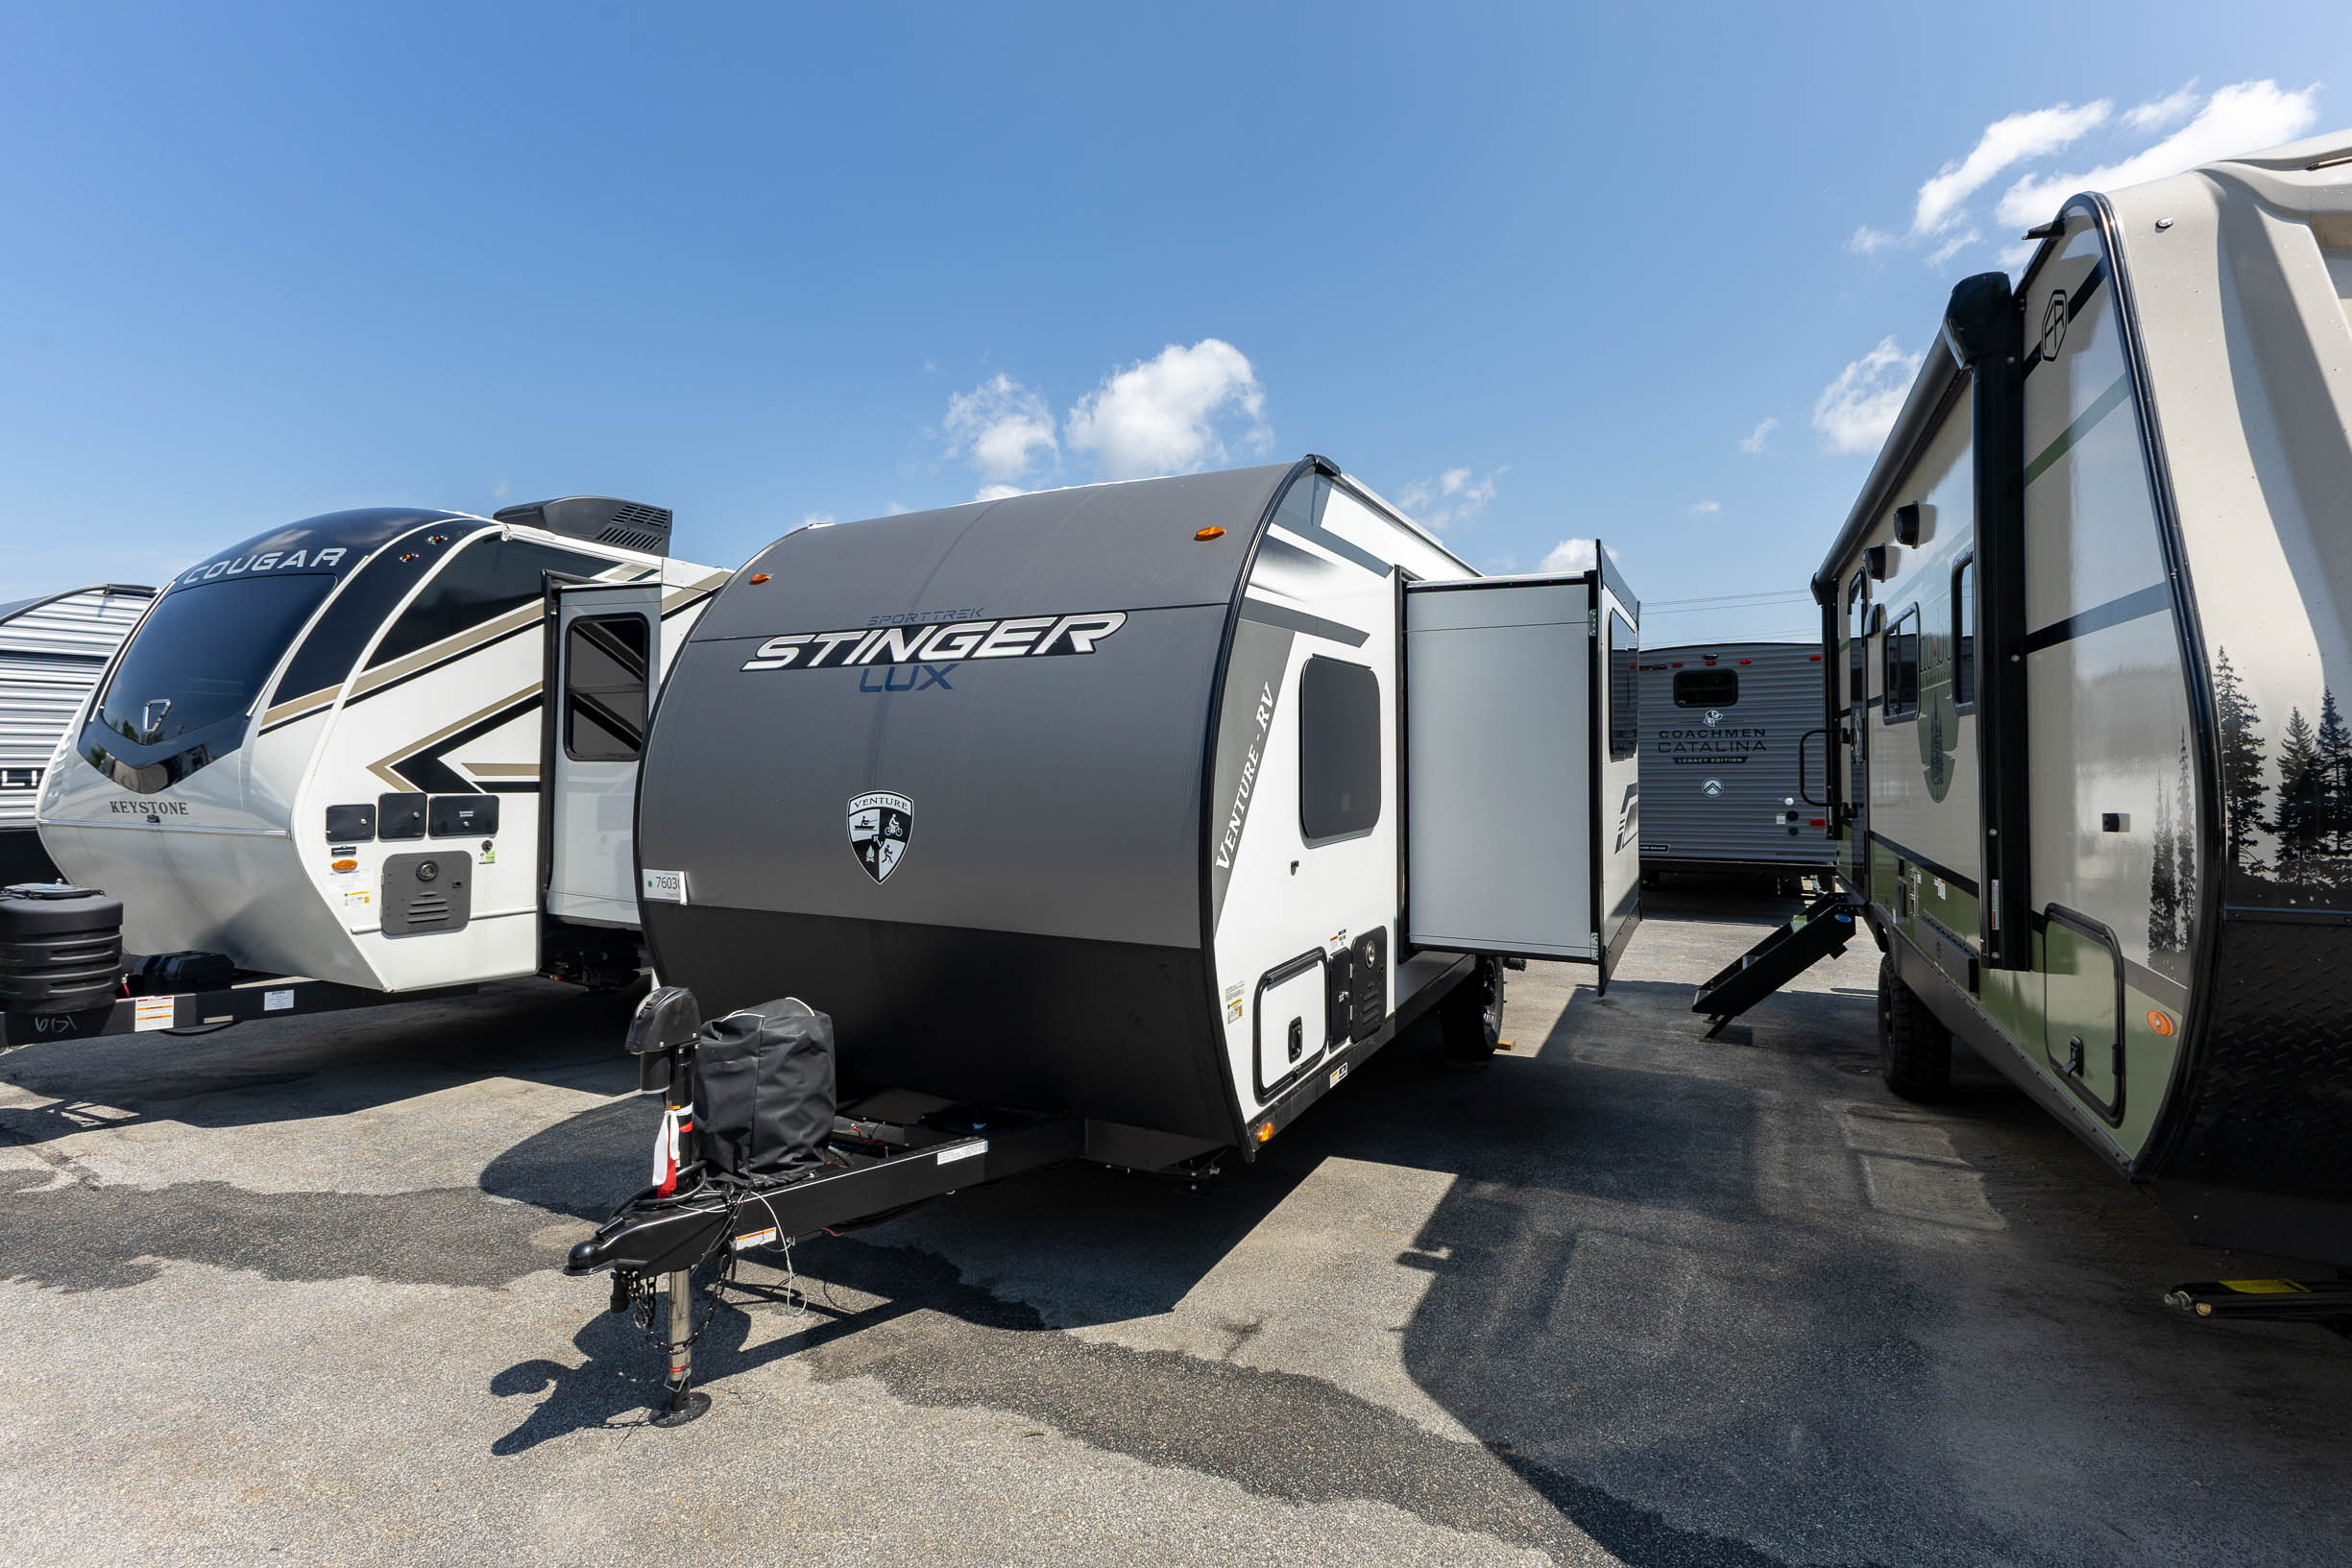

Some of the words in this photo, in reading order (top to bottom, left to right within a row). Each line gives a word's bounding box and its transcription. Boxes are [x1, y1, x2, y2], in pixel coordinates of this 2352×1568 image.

[182, 547, 348, 585] COUGAR
[867, 608, 984, 627] SPORTTREK
[740, 612, 1128, 671] STINGER
[859, 663, 960, 692] LUX
[1659, 728, 1766, 739] COACHMEN
[1658, 739, 1767, 754] CATALINA
[1215, 744, 1260, 870] VENTURE
[1255, 681, 1274, 733] RV
[109, 800, 189, 815] KEYSTONE
[854, 796, 909, 810] VENTURE
